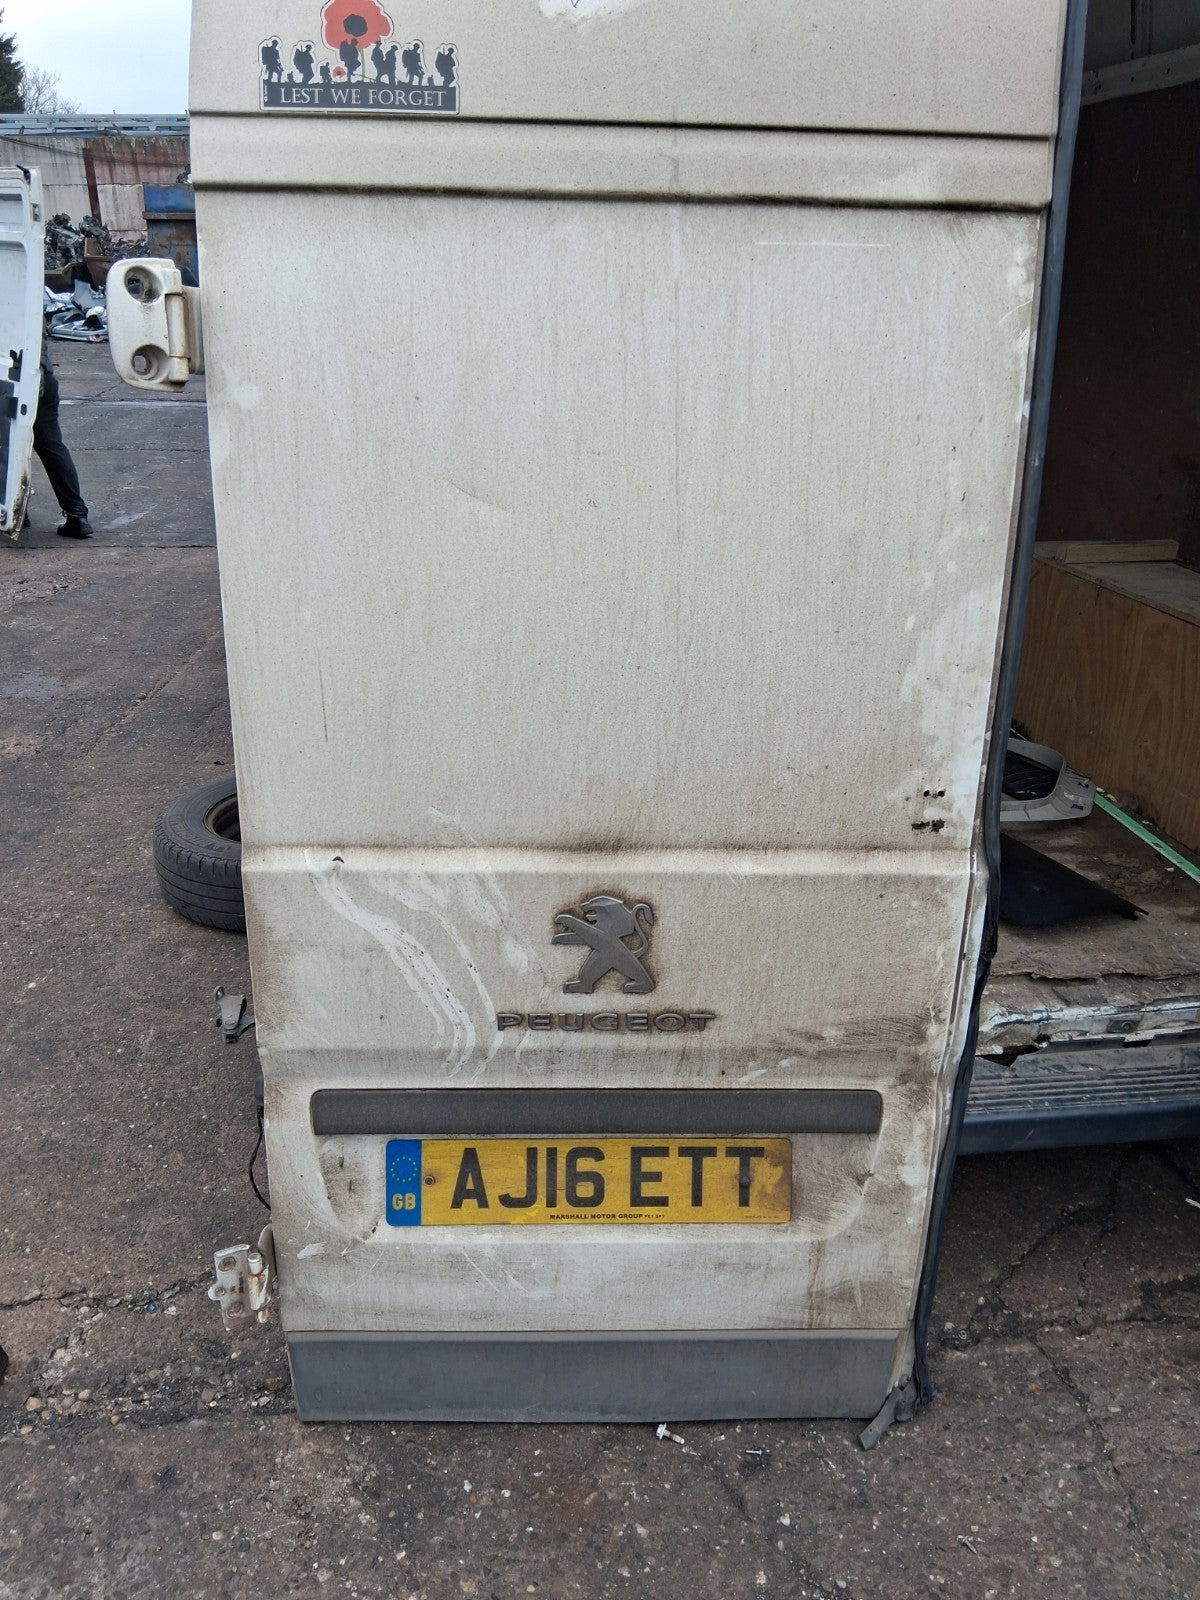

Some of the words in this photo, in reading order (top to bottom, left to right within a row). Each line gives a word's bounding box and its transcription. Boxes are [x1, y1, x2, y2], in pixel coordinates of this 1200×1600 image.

[280, 87, 323, 104] LEST
[331, 88, 361, 105] WE
[368, 89, 447, 107] FORGET
[496, 1011, 717, 1032] PEUGEOT
[450, 1146, 606, 1209] AJ16
[629, 1146, 765, 1208] ETT
[392, 1193, 416, 1211] GB
